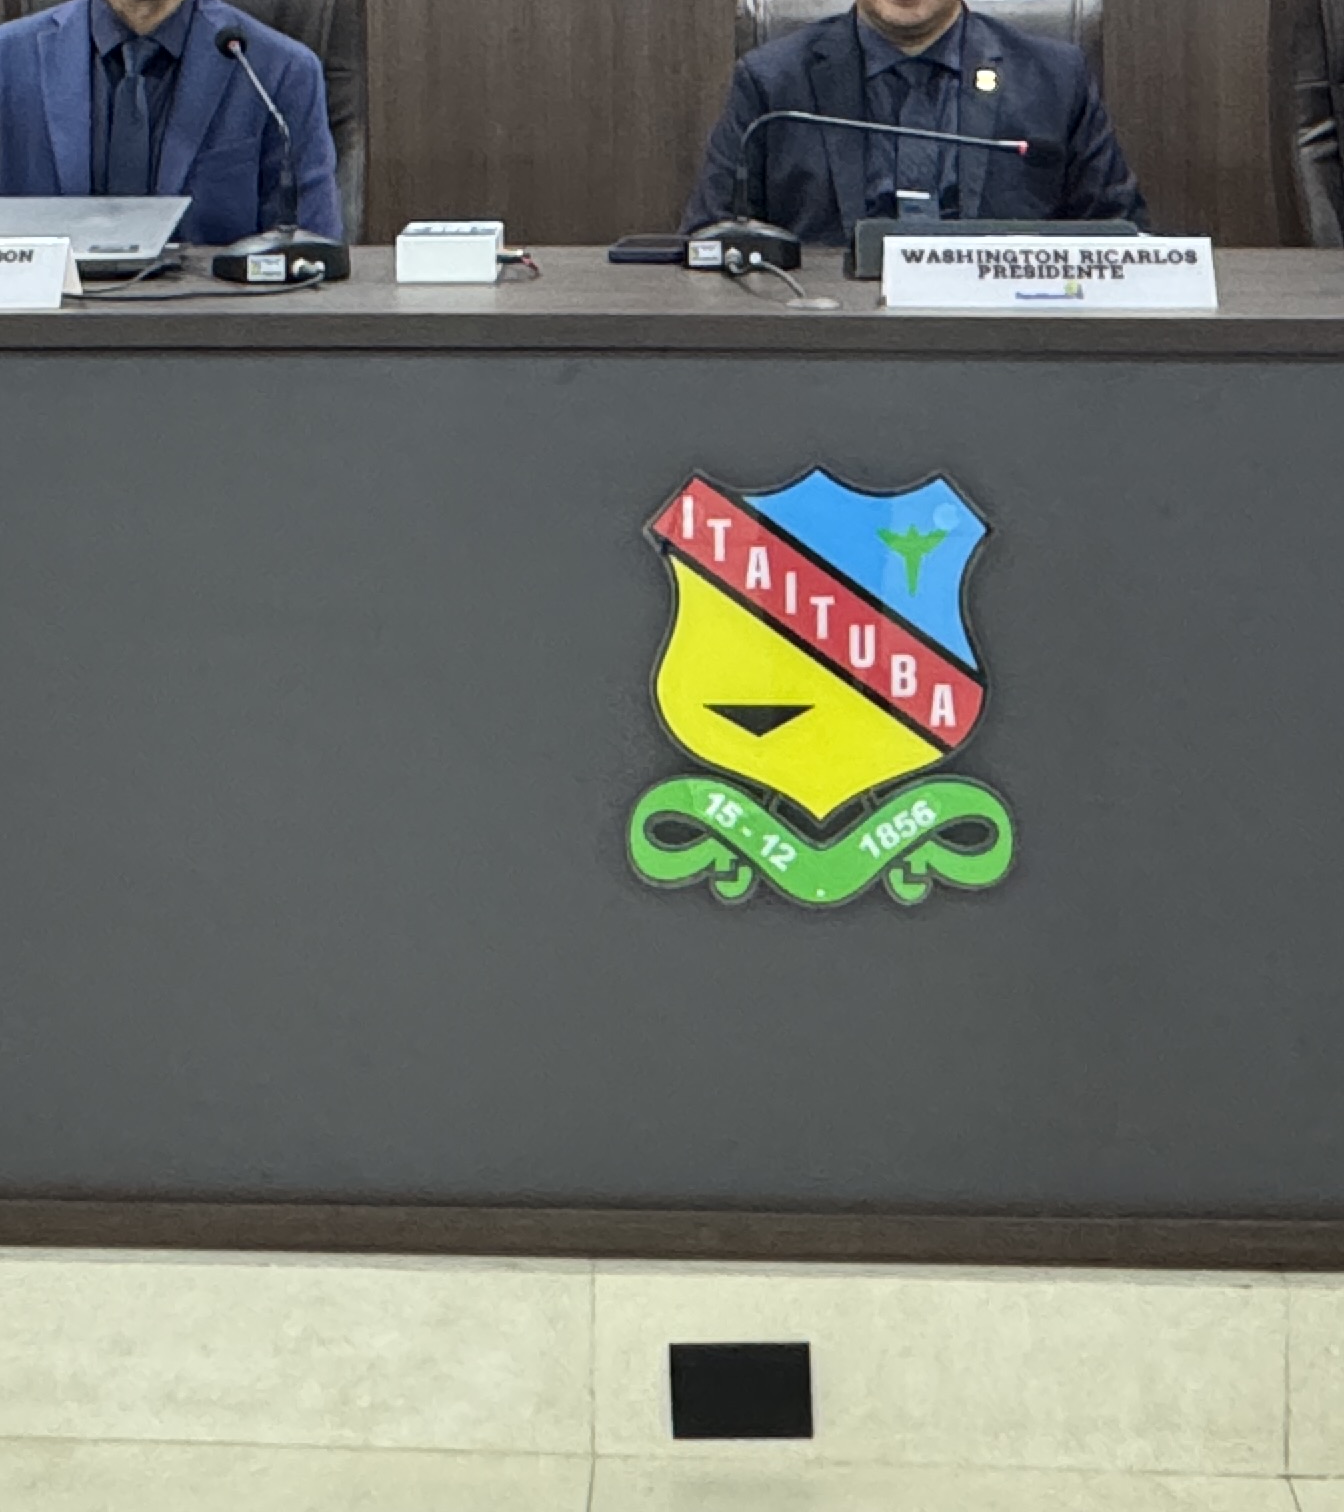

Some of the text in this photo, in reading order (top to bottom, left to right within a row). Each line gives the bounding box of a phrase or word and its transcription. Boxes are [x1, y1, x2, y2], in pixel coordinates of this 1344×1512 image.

[900, 248, 1199, 265] WASHINGTON RICARLOS
[977, 264, 1126, 280] PRESIDENTE
[681, 494, 957, 728] ITAITUBA
[703, 792, 743, 830] 15
[757, 833, 798, 872] 12
[859, 799, 939, 859] 1856
